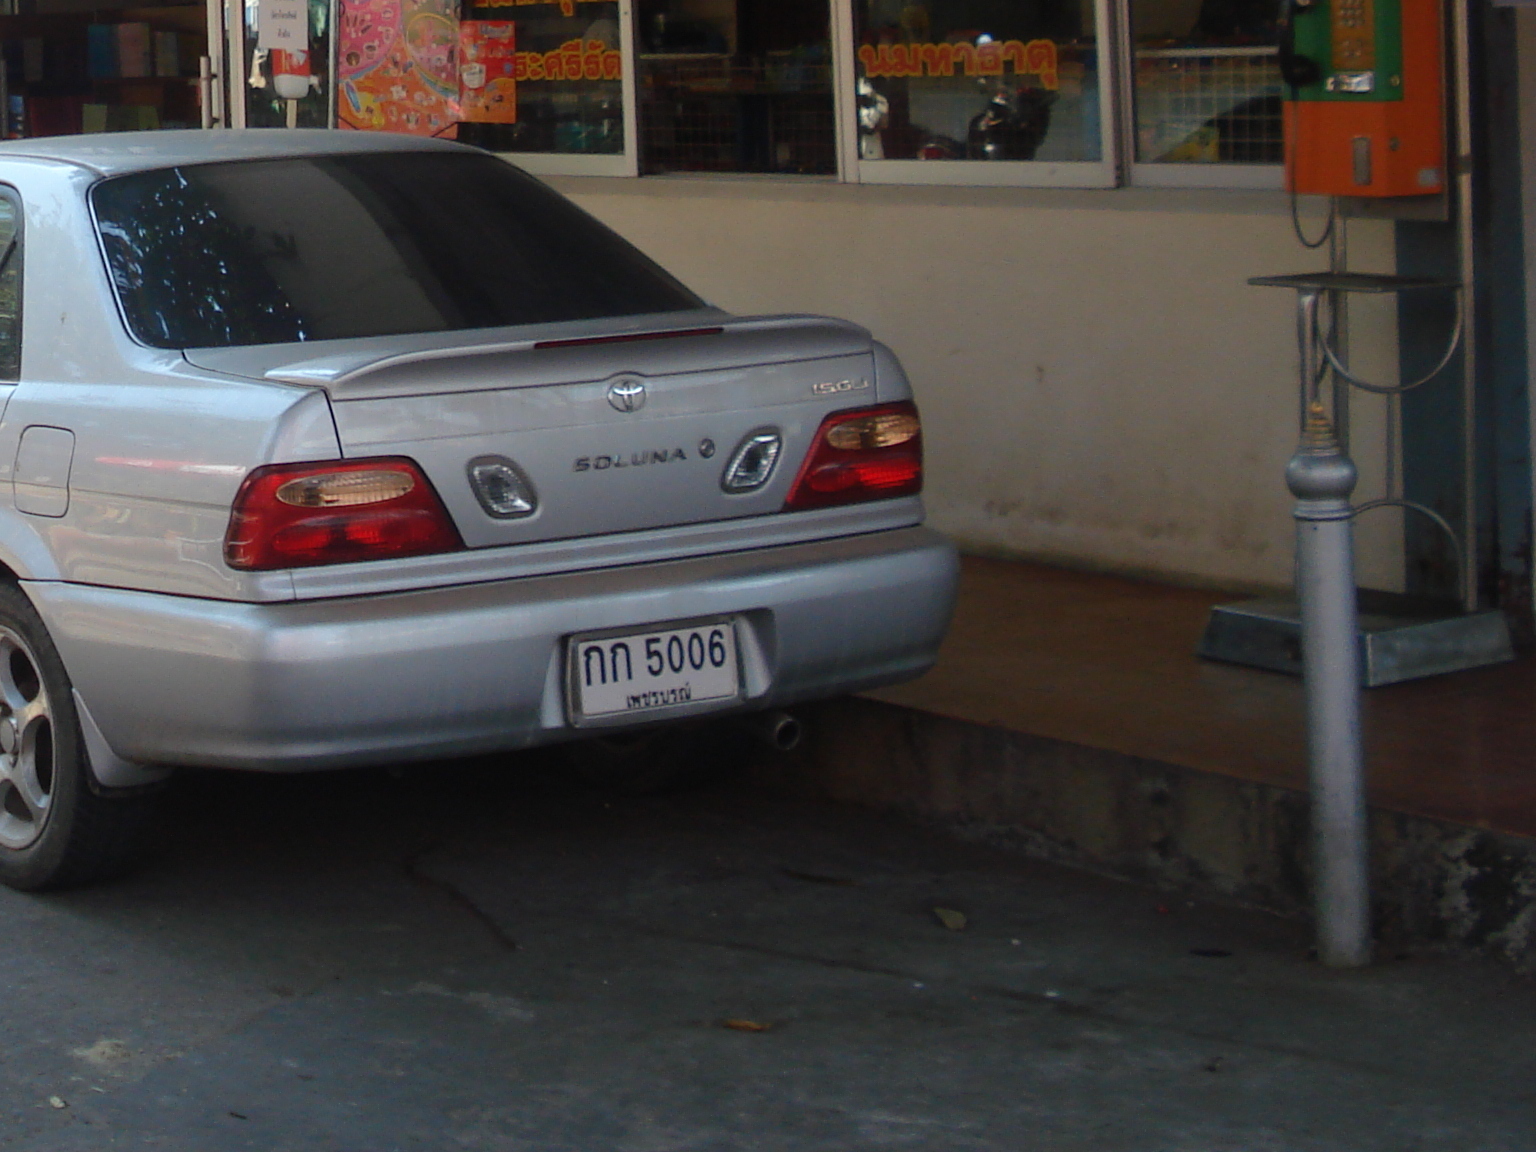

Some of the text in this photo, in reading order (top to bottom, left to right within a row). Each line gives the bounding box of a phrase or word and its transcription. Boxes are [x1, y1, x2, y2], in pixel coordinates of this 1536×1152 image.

[858, 39, 1060, 91] นมหาธาตุ
[573, 448, 687, 473] SOLUNA
[584, 629, 726, 686] กก 5006
